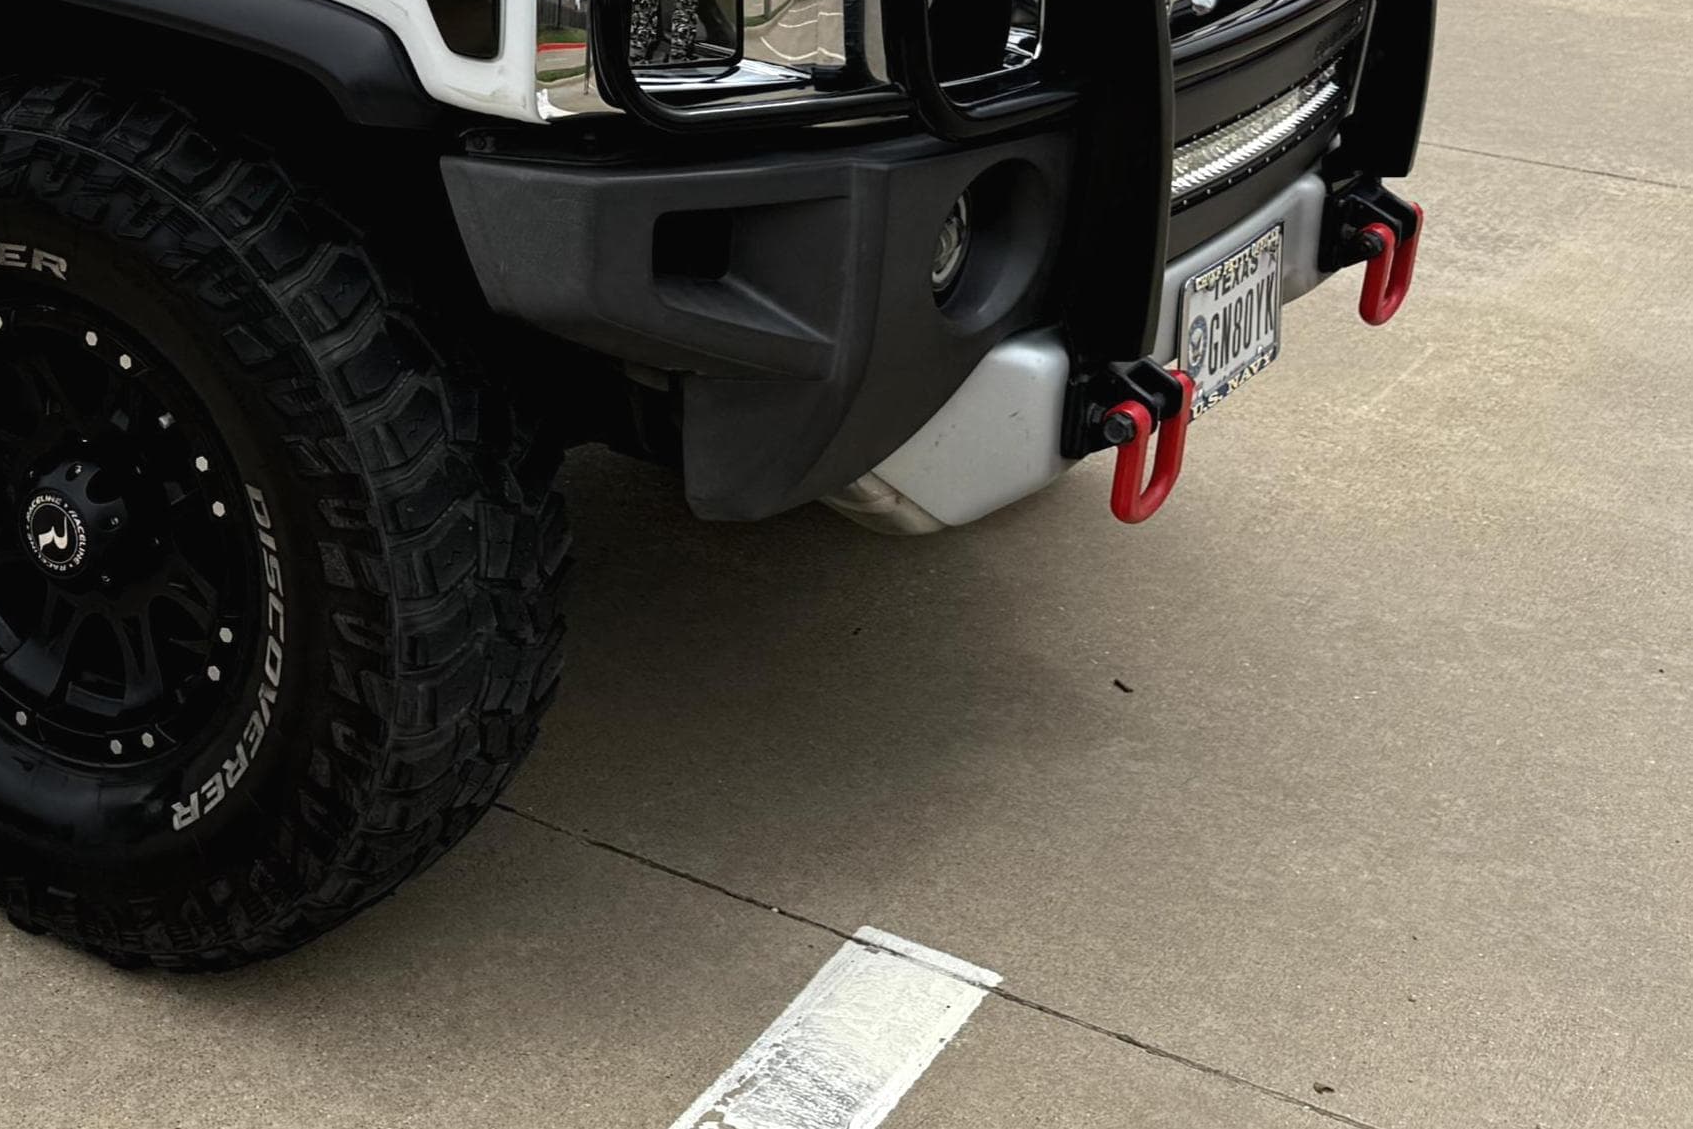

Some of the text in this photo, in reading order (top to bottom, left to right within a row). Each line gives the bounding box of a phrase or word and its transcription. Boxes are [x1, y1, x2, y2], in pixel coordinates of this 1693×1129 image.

[1213, 255, 1259, 301] TEXAS
[1227, 348, 1274, 391] NAVY
[172, 483, 285, 831] DISCOVERER
